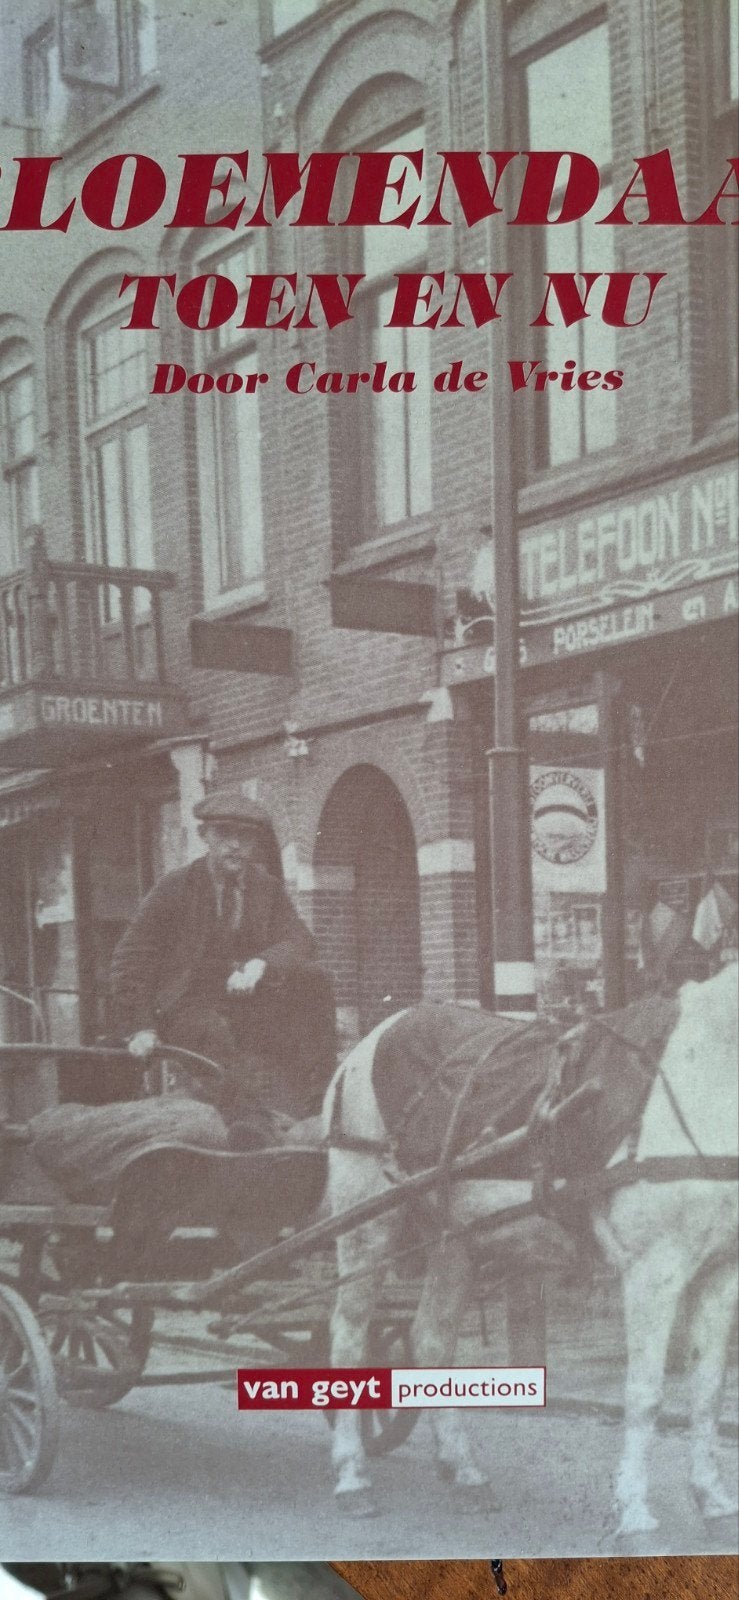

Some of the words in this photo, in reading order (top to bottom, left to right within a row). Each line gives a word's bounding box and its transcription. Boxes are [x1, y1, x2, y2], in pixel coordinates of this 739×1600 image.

[0, 148, 739, 233] LOEMENDA
[119, 273, 366, 331] TOEN
[384, 271, 514, 330] EN
[530, 272, 667, 328] NU
[150, 363, 268, 395] Door
[286, 361, 416, 395] Carla
[434, 360, 487, 393] de
[508, 360, 624, 393] Vries
[519, 491, 680, 600] TELEFOON
[41, 696, 163, 728] GROENTEN
[243, 1380, 299, 1399] van
[311, 1376, 381, 1405] geyt
[398, 1377, 538, 1403] productions
